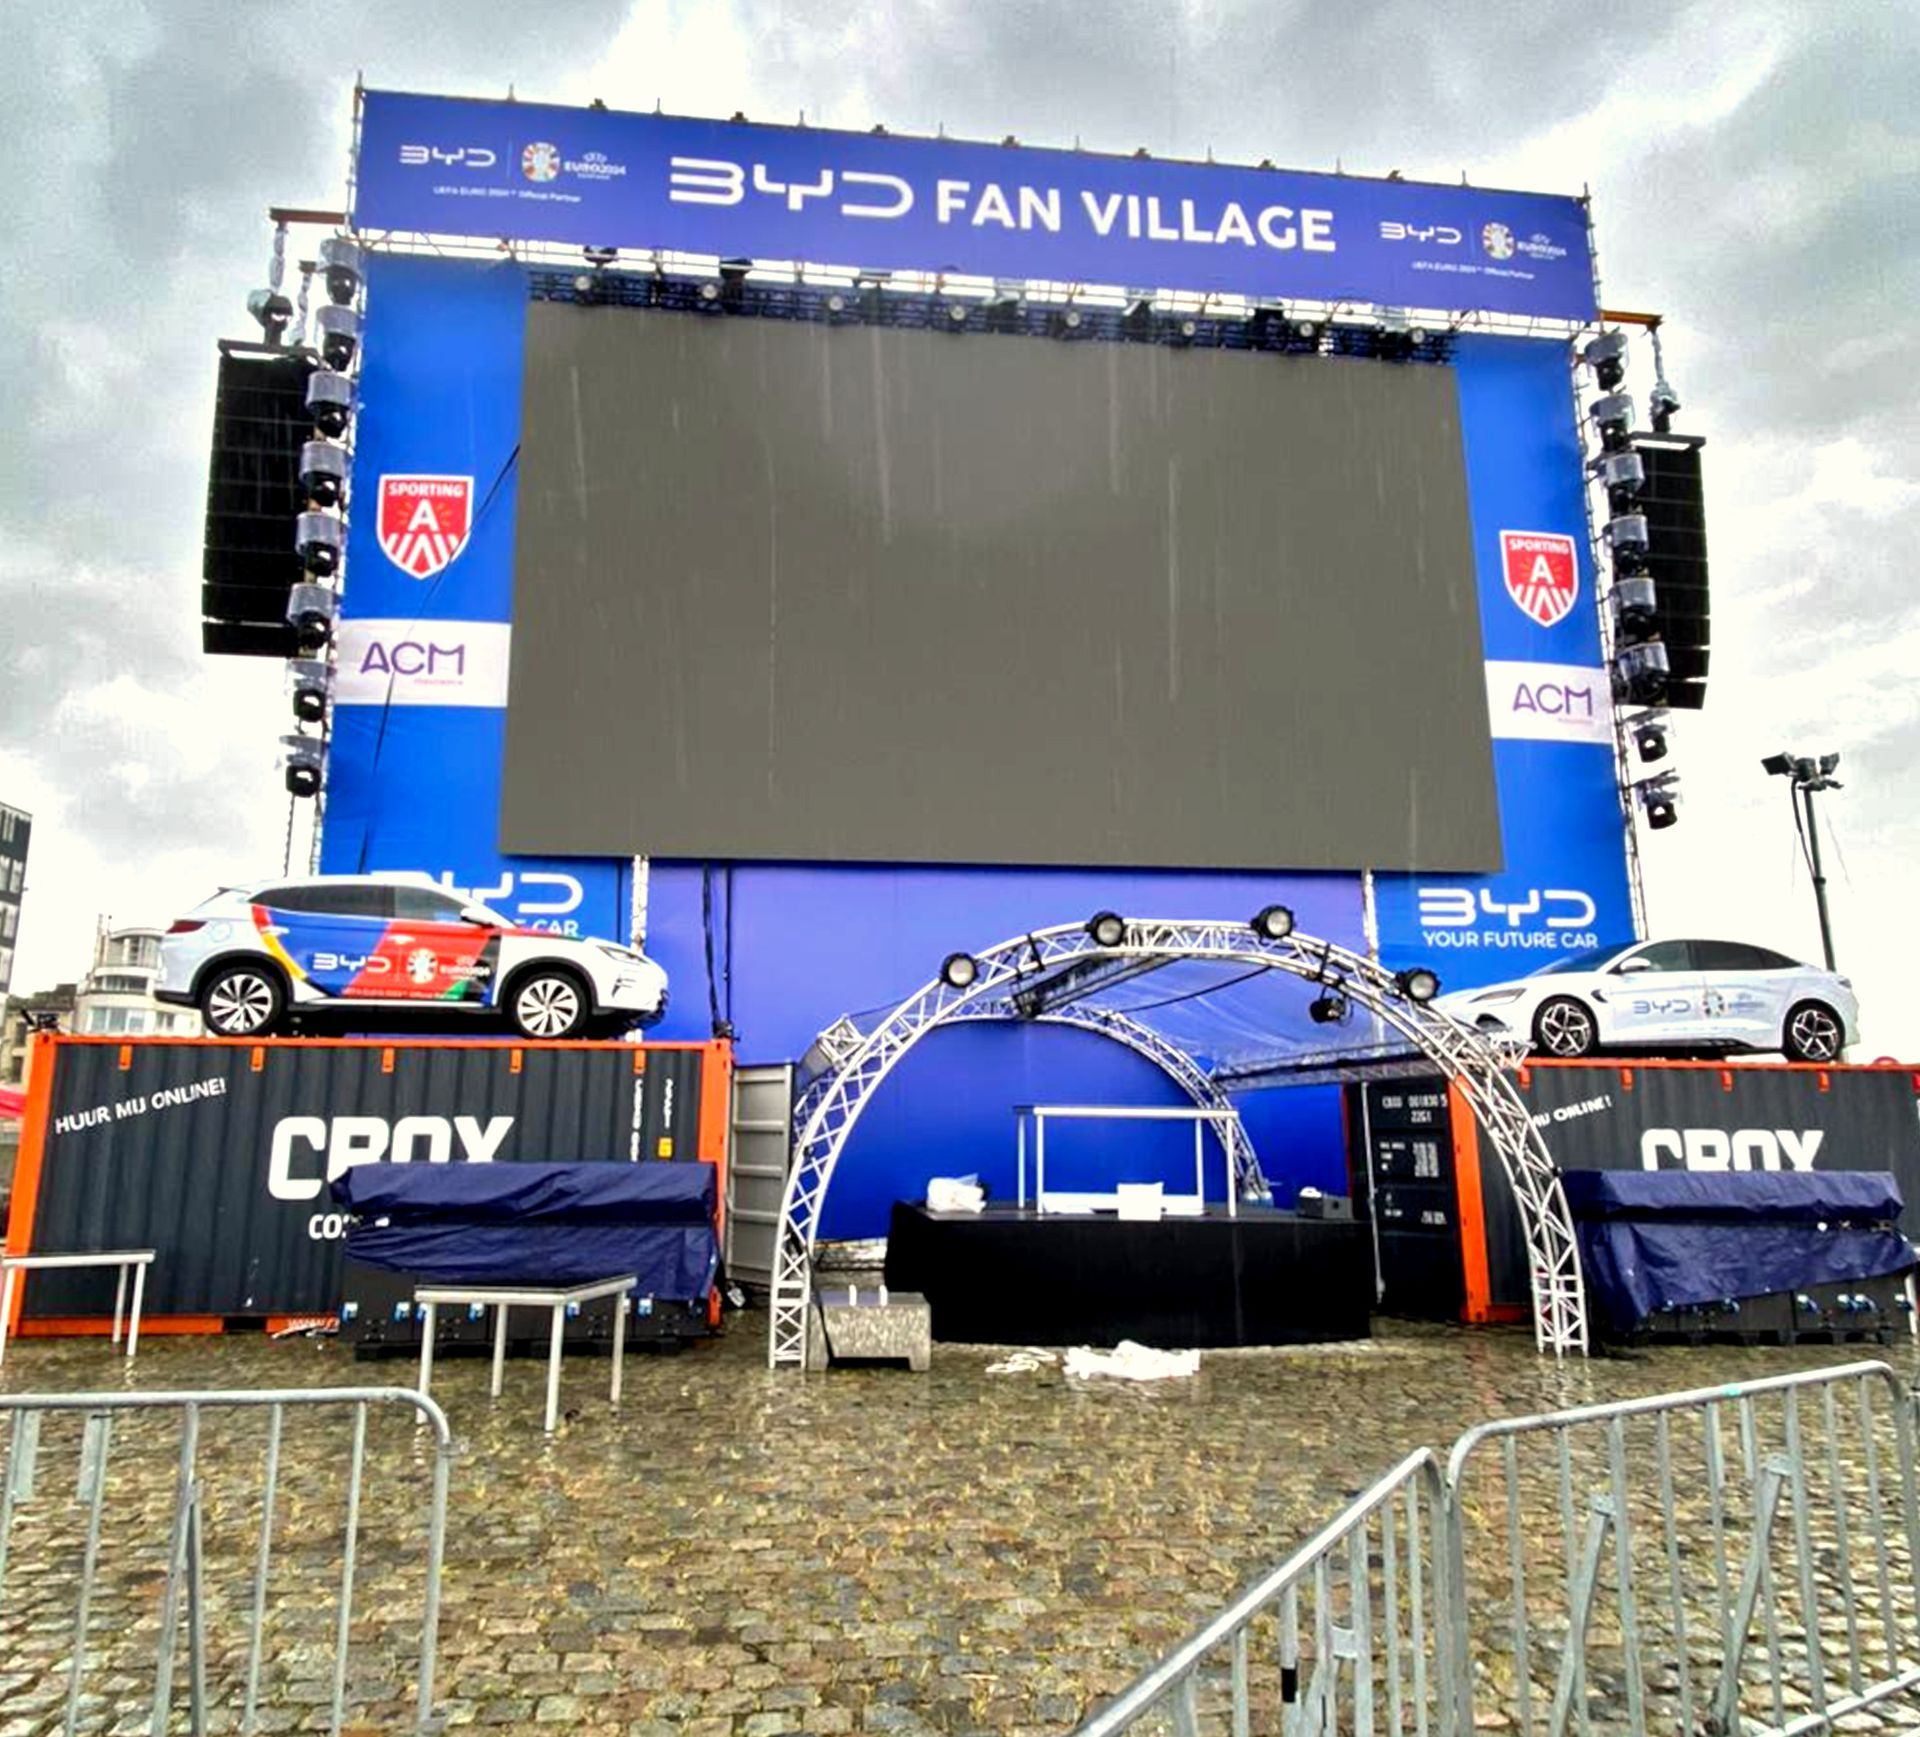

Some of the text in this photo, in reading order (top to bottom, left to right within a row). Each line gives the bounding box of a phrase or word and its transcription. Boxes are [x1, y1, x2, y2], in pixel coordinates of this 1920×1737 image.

[399, 145, 496, 167] BYD
[669, 156, 1336, 252] BYD FAN VILLAGE
[1379, 221, 1462, 244] BYD
[388, 482, 465, 497] SPORTING
[1509, 538, 1569, 554] SPORTING
[360, 642, 465, 675] ACM
[1512, 682, 1592, 715] ACM
[1418, 888, 1596, 927] BYD
[1423, 931, 1598, 949] YOUR FUTURE CAR
[312, 952, 390, 972] BYD
[1632, 999, 1691, 1014] BYD
[55, 1105, 111, 1135] HUUR
[151, 1077, 227, 1109] ONLINE!
